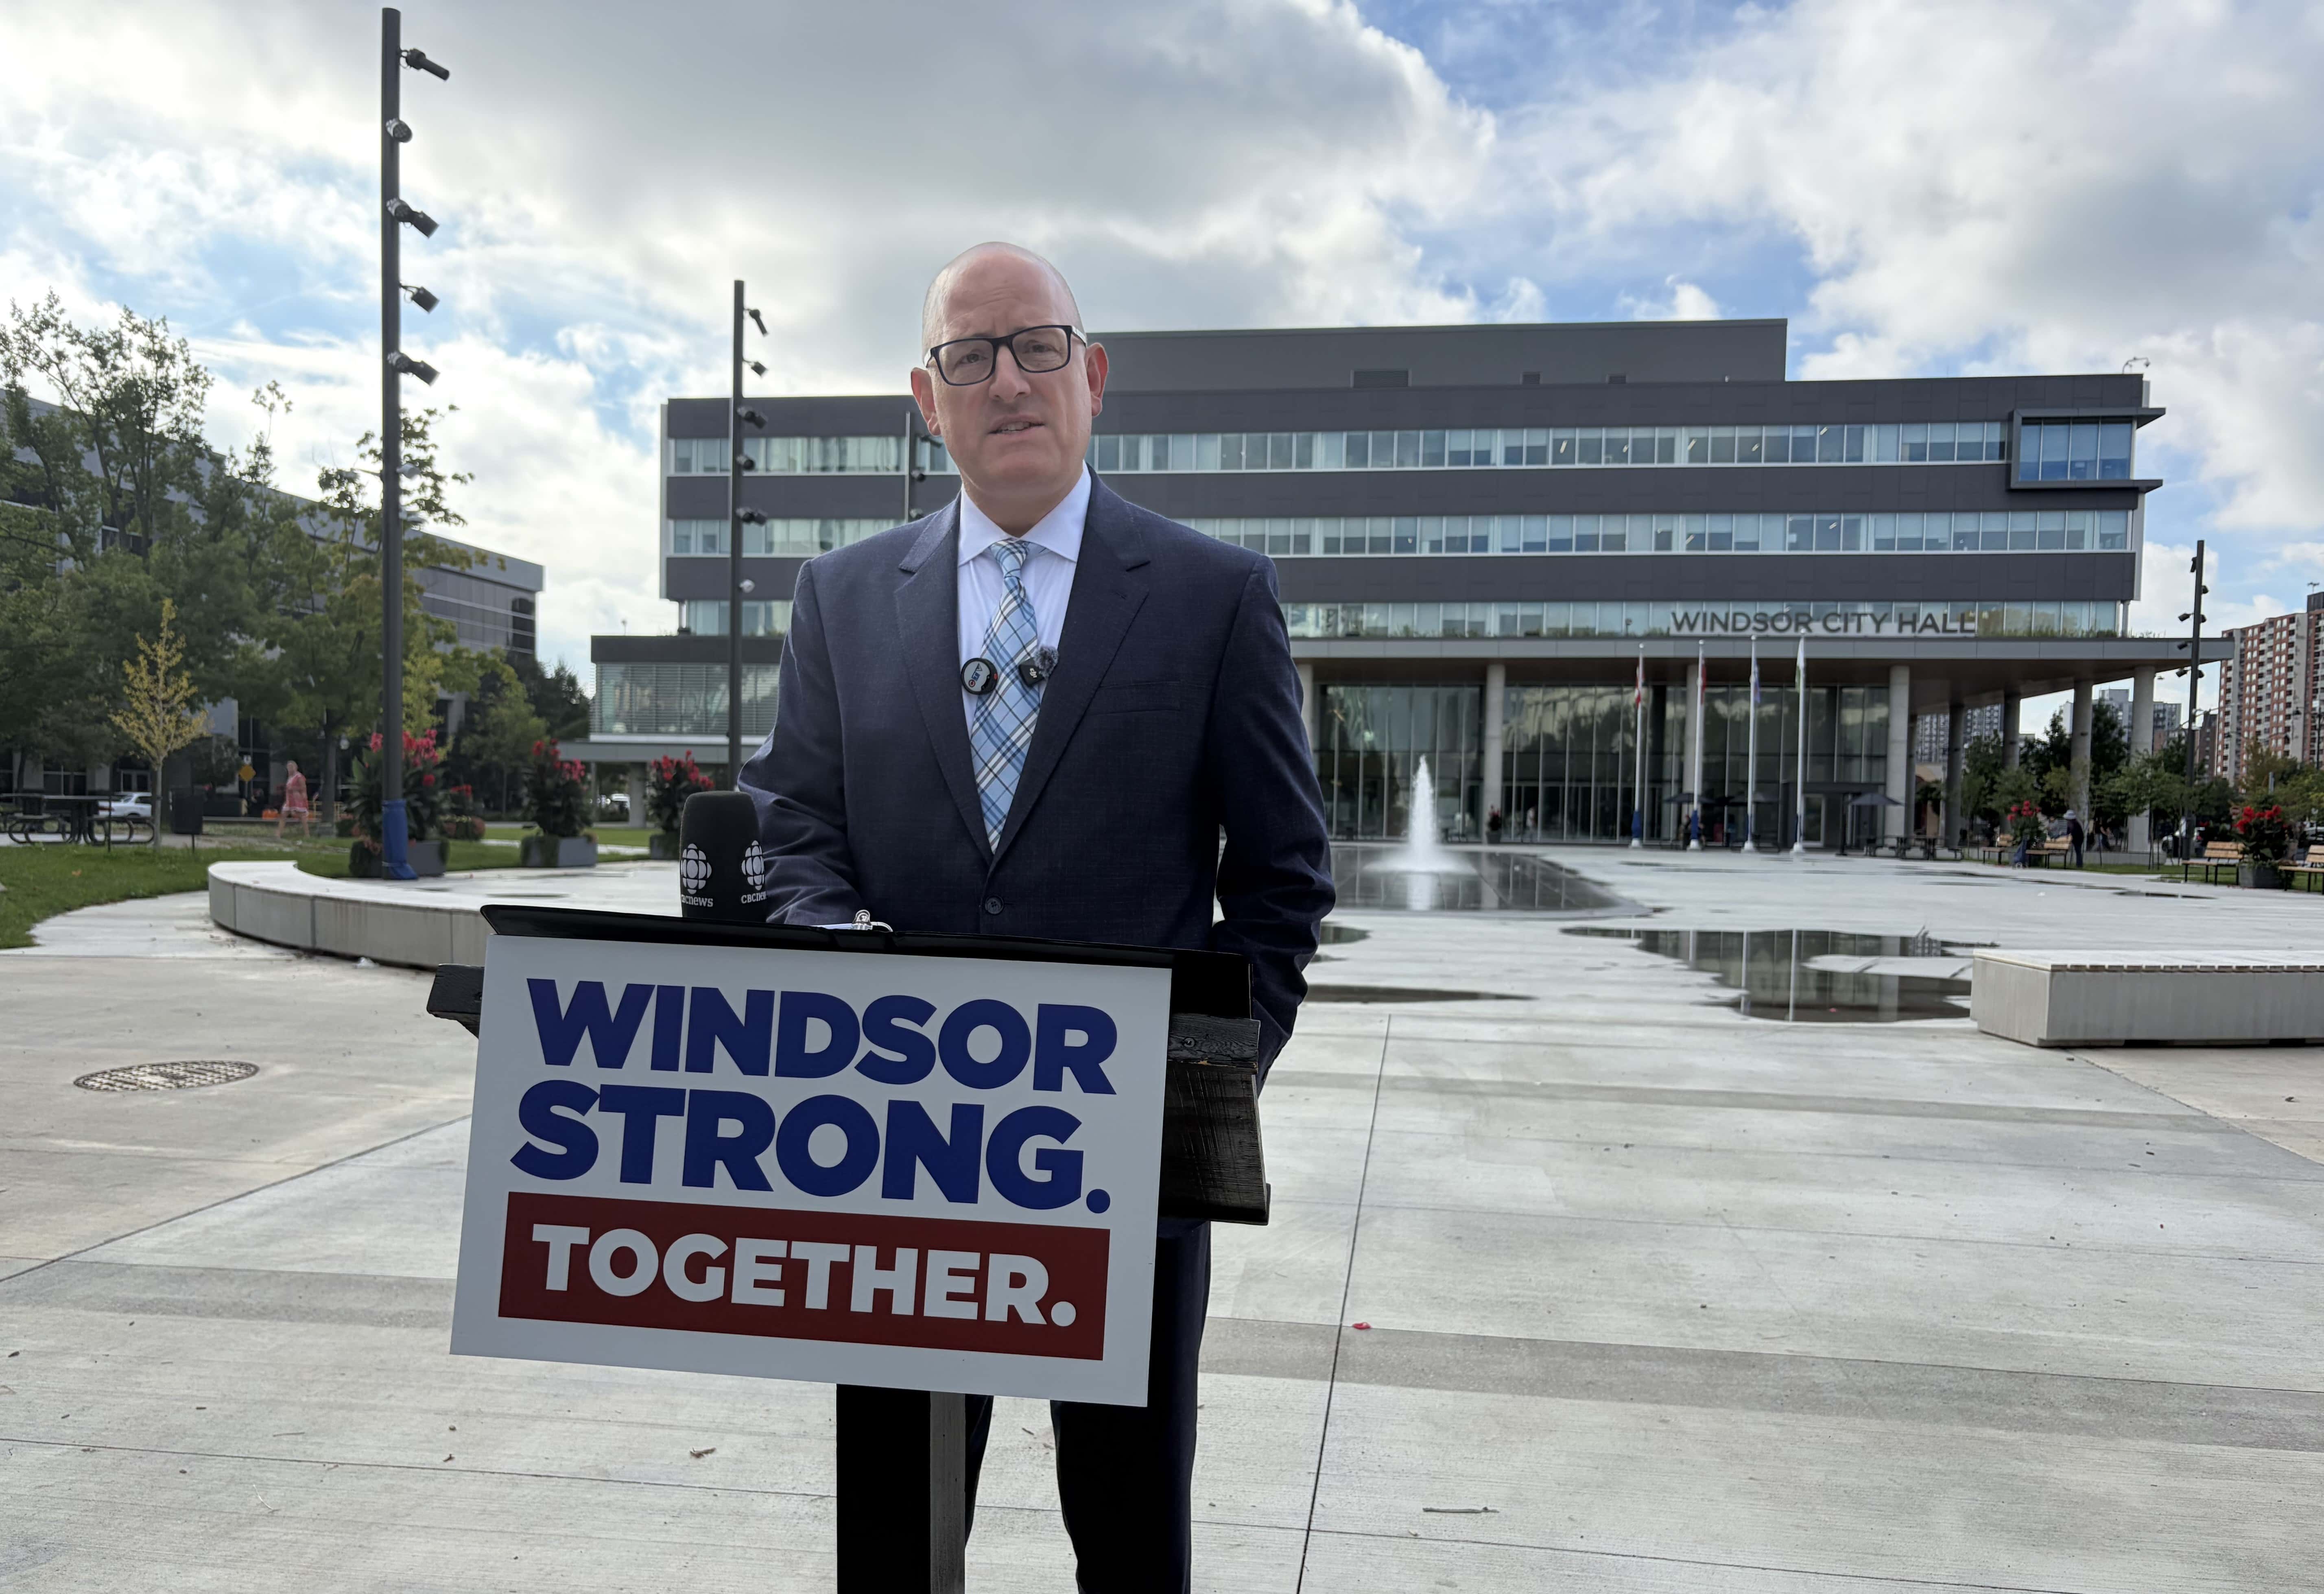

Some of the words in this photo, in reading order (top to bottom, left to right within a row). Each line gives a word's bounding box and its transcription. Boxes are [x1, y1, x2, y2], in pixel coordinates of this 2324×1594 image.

[1671, 612, 1813, 633] WINDSOR
[1822, 612, 1888, 634] CITY
[1898, 612, 1976, 634] HALL
[527, 978, 1117, 1095] WINDSOR
[510, 1080, 1111, 1214] STRONG.
[531, 1223, 1077, 1327] TOGETHER.
